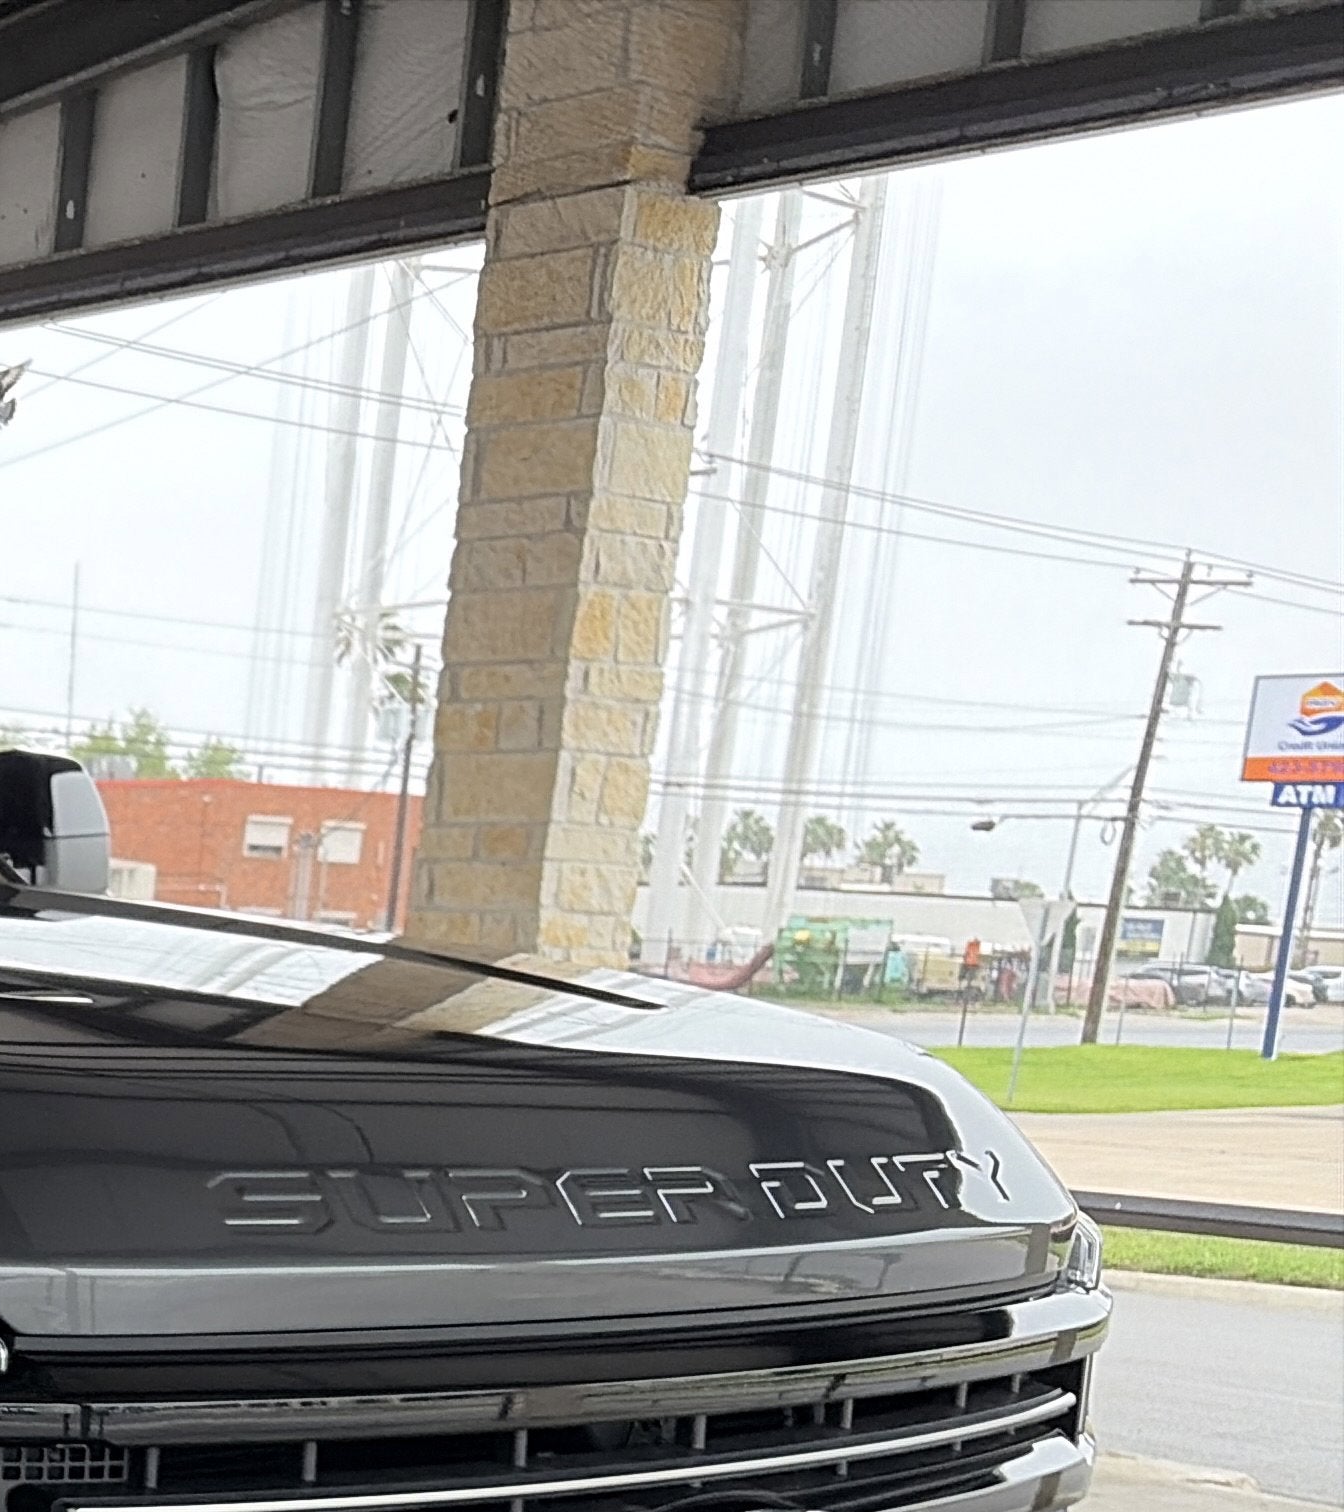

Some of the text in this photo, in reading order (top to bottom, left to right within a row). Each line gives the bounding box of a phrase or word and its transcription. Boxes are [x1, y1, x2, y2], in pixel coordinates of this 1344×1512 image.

[1276, 784, 1336, 805] ATM
[206, 1149, 1014, 1237] SUPER DUTY
